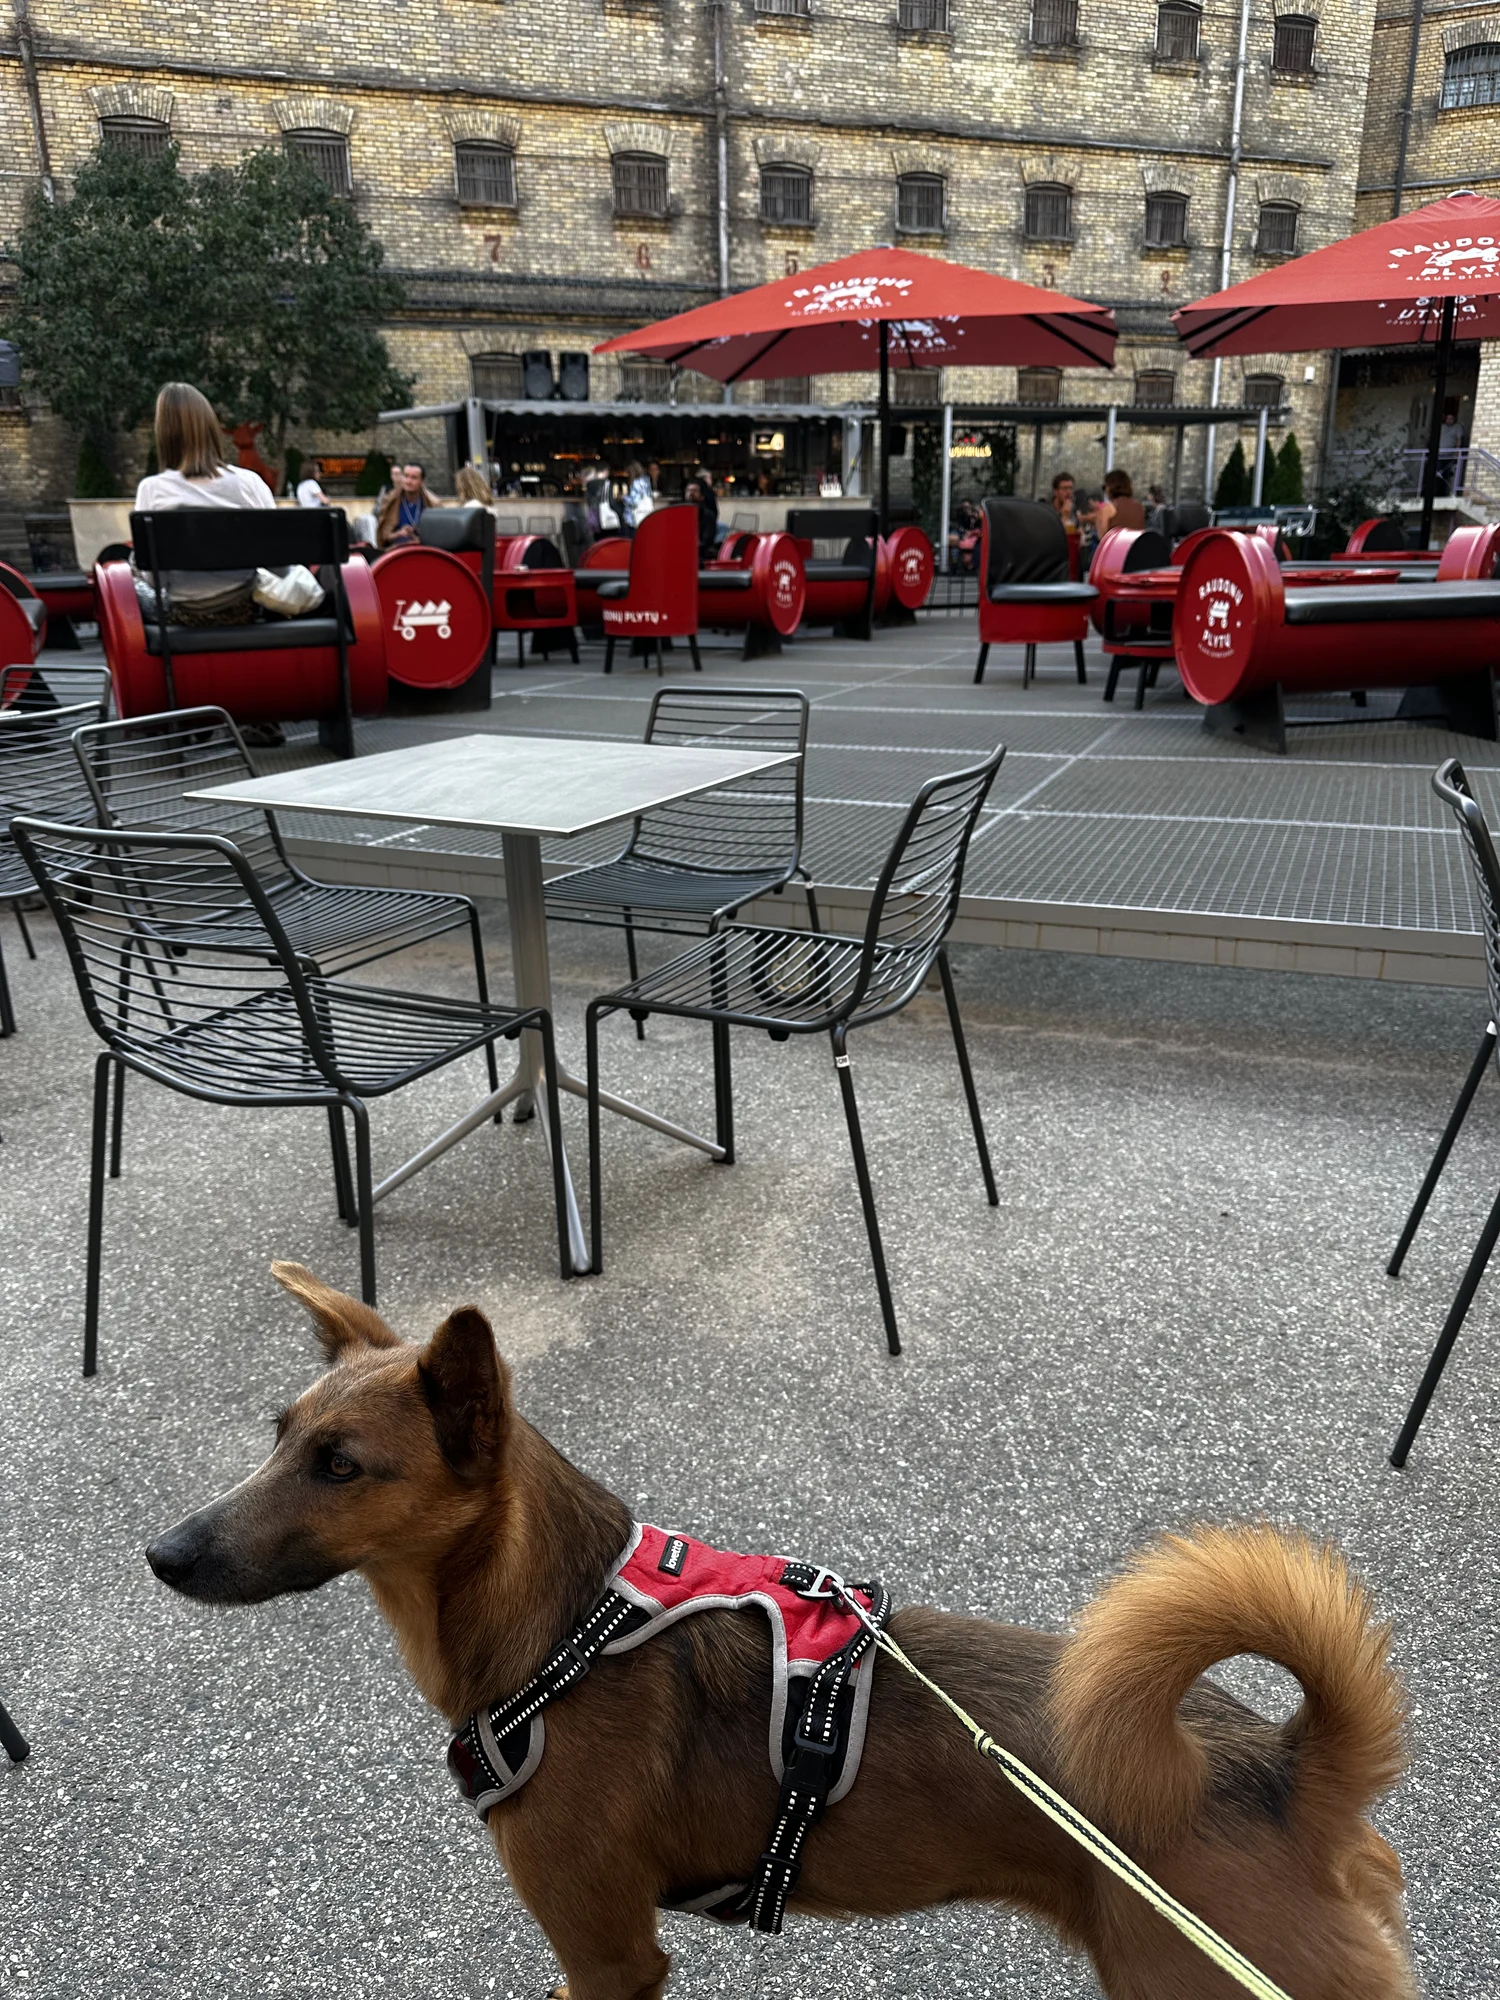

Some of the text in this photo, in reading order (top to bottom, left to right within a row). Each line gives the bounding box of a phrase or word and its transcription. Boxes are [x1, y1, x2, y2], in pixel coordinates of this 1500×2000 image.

[483, 234, 502, 262] 7
[1389, 237, 1500, 257] RAUDO
[785, 251, 798, 276] 5
[1420, 264, 1500, 276] PLYT
[1042, 264, 1056, 289] 3
[665, 1540, 684, 1570] lovetto
